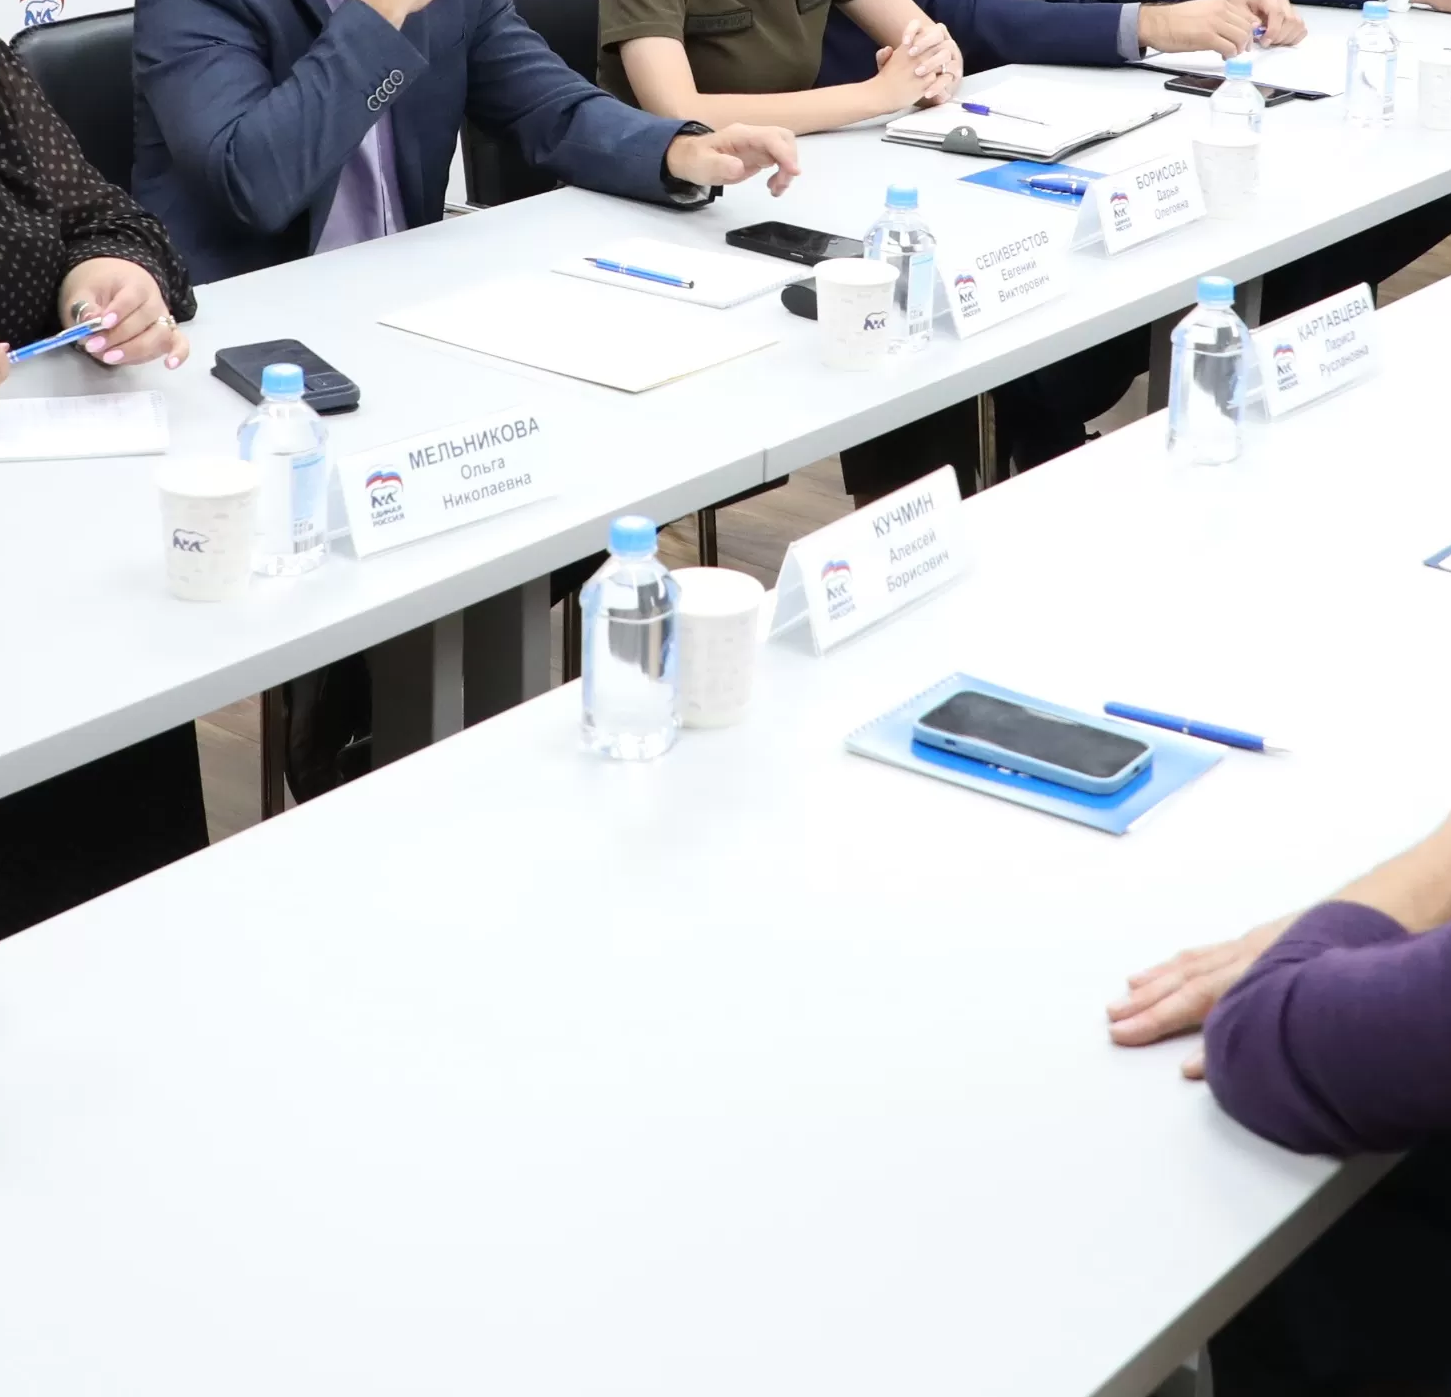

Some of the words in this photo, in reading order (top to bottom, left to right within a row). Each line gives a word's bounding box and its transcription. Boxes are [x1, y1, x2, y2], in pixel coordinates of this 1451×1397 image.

[1136, 160, 1188, 189] БОРИСОВА
[1157, 186, 1179, 201] Дарья
[976, 231, 1049, 270] СЕЛИВЕРСТОВ
[1001, 257, 1037, 281] Евгений
[998, 273, 1050, 303] Викторович
[1297, 296, 1369, 342] КАРТАВЦЕВА
[409, 417, 540, 470] МЕЛЬНИКОВА
[461, 457, 505, 479] Ольга
[443, 473, 532, 510] Николаевна
[872, 492, 934, 538] КУЧМИН
[890, 528, 936, 564] Алексей
[886, 550, 949, 592] Борисович
